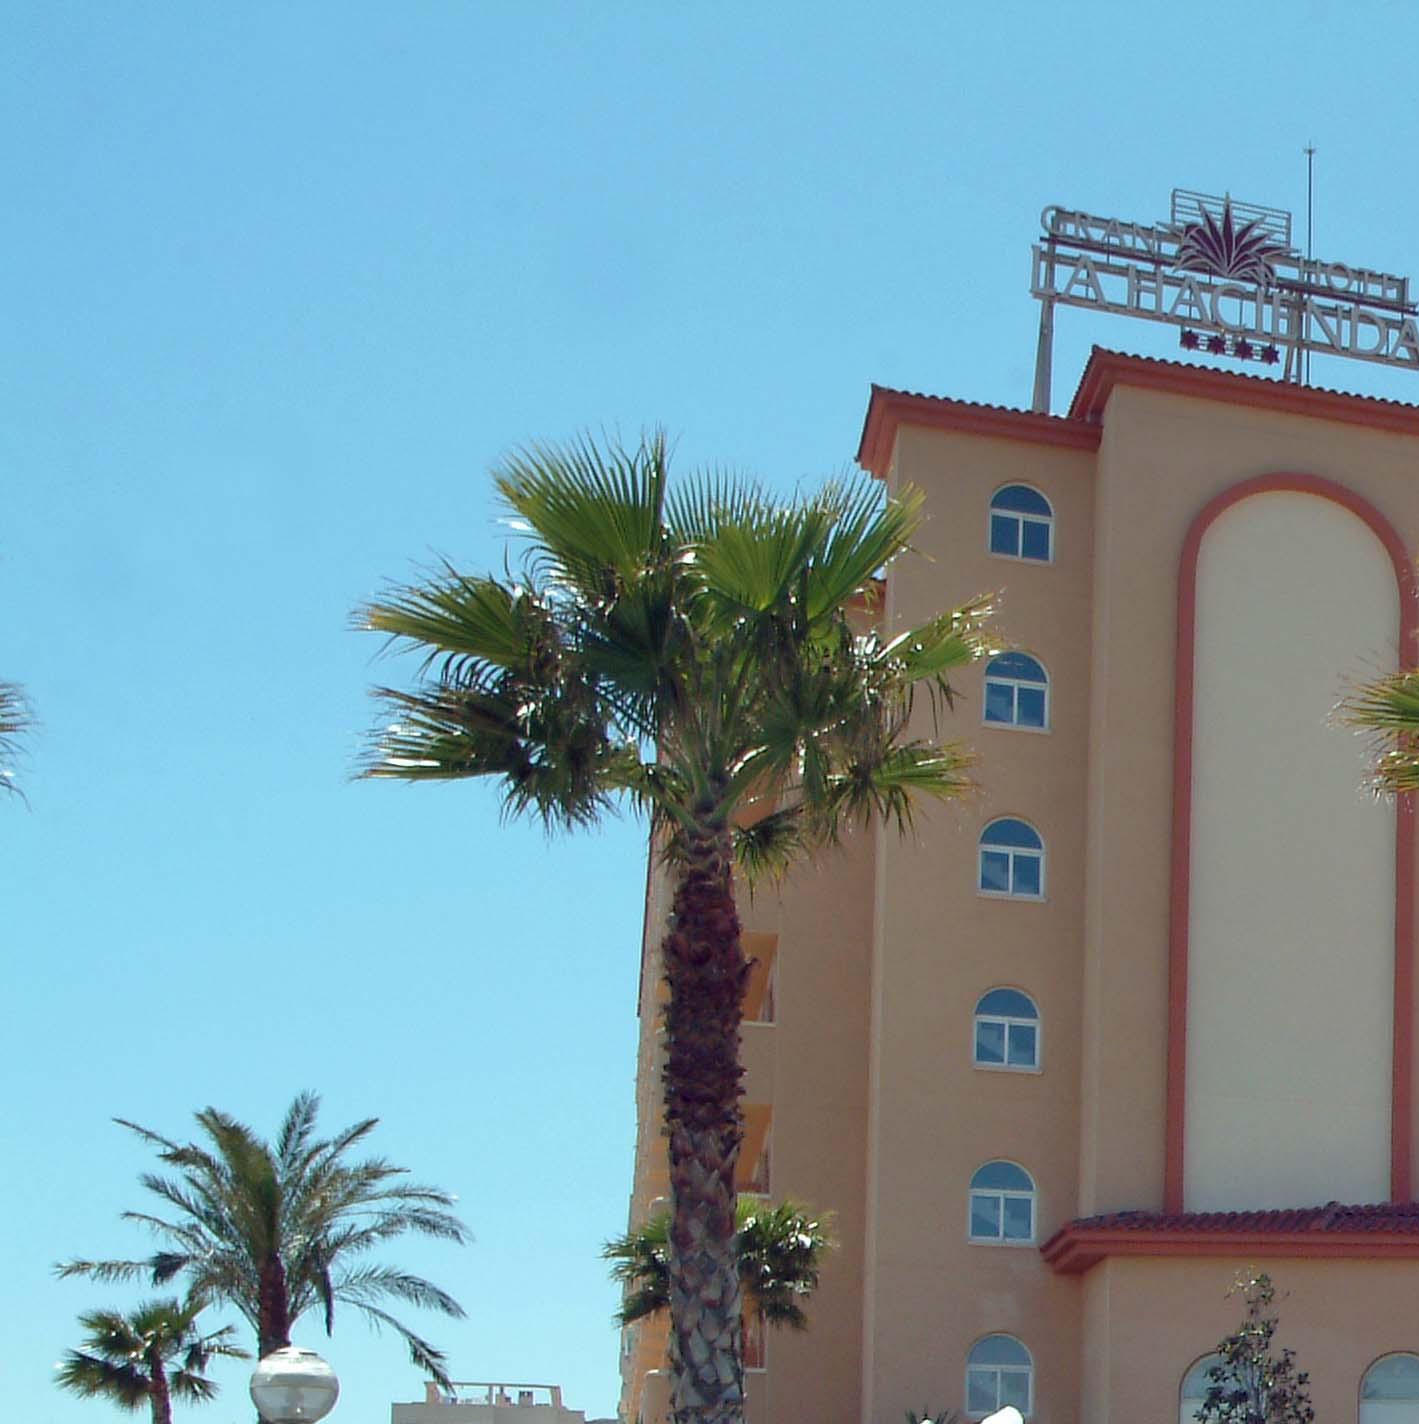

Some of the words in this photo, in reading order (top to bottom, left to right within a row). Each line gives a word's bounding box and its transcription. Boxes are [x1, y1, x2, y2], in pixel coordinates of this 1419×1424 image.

[1029, 244, 1108, 305] LA
[1041, 205, 1162, 258] GRAN
[1298, 256, 1419, 308] HOTEL
